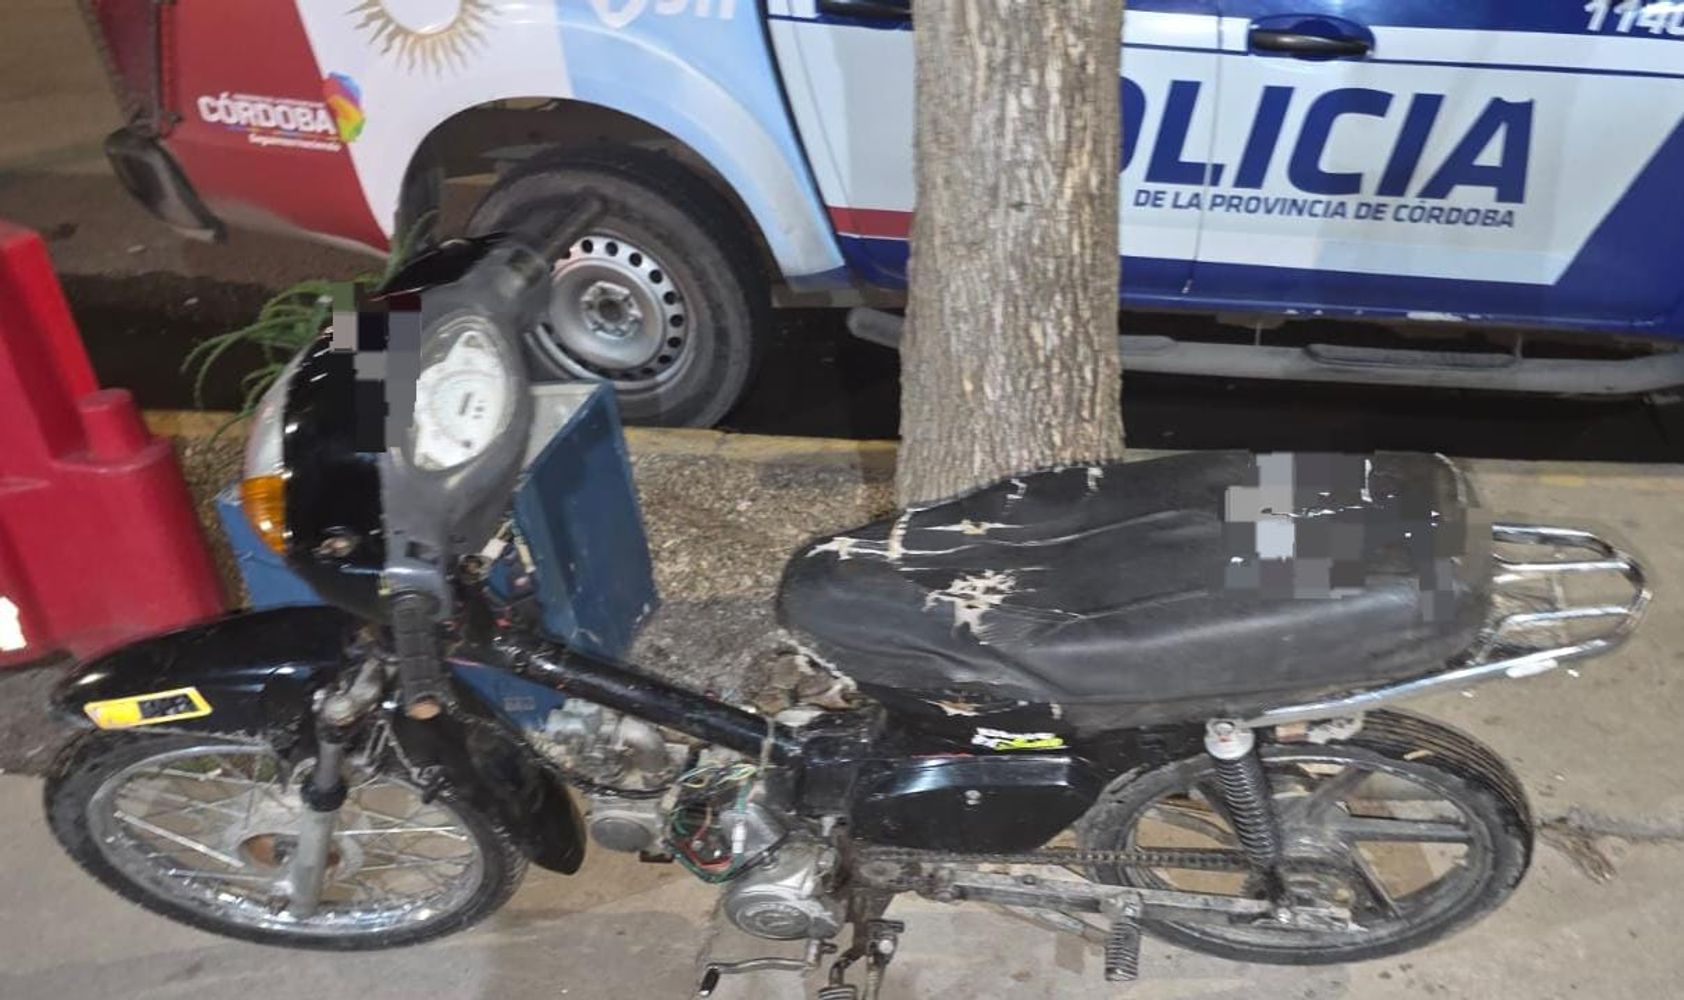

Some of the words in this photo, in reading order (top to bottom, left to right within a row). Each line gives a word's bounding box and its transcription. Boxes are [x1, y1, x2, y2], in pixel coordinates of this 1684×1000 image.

[197, 91, 337, 134] CÓRDOBA
[1119, 76, 1534, 204] LICIA
[1133, 189, 1167, 208] DE
[1171, 192, 1201, 210] LA
[1209, 194, 1347, 220] PROVINCIA
[1354, 202, 1388, 222] DE
[1393, 200, 1515, 228] CÓRDOBA
